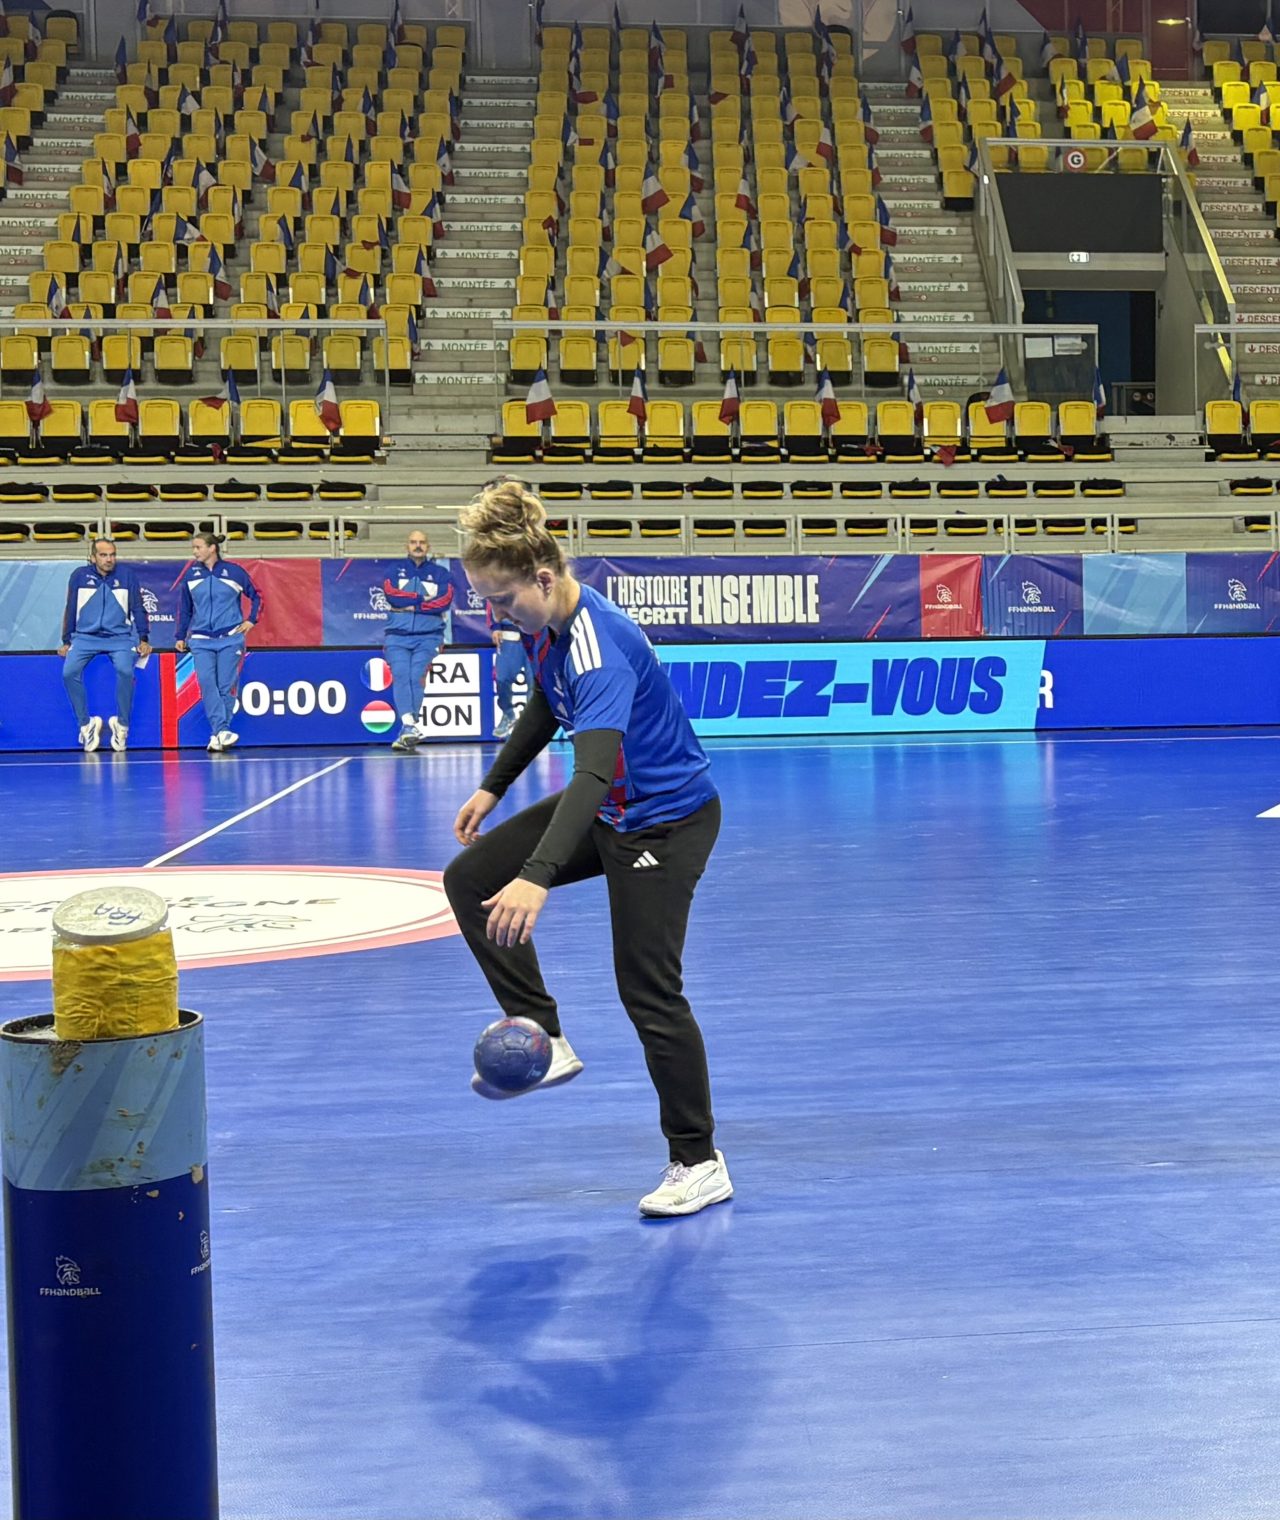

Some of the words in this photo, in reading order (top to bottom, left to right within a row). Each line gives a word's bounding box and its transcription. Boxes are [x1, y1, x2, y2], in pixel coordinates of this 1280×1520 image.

[1071, 154, 1082, 166] G
[1214, 230, 1261, 239] DESCENTE
[456, 251, 500, 259] MONTÉE
[902, 255, 944, 263] MONTÉE
[1224, 258, 1273, 266] DESCENTE
[451, 279, 496, 288] MONTÉE
[907, 283, 950, 291] MONTÉE
[446, 309, 492, 319] MONTÉE
[912, 312, 955, 322] MONTÉE
[441, 338, 488, 350] MONTÉE
[917, 343, 961, 353] MONTÉE
[436, 374, 484, 384] MONTÉE
[924, 375, 968, 386] MONTÉE
[689, 574, 820, 625] ENSEMBLE
[429, 662, 470, 684] RA
[233, 680, 347, 717] 0:00
